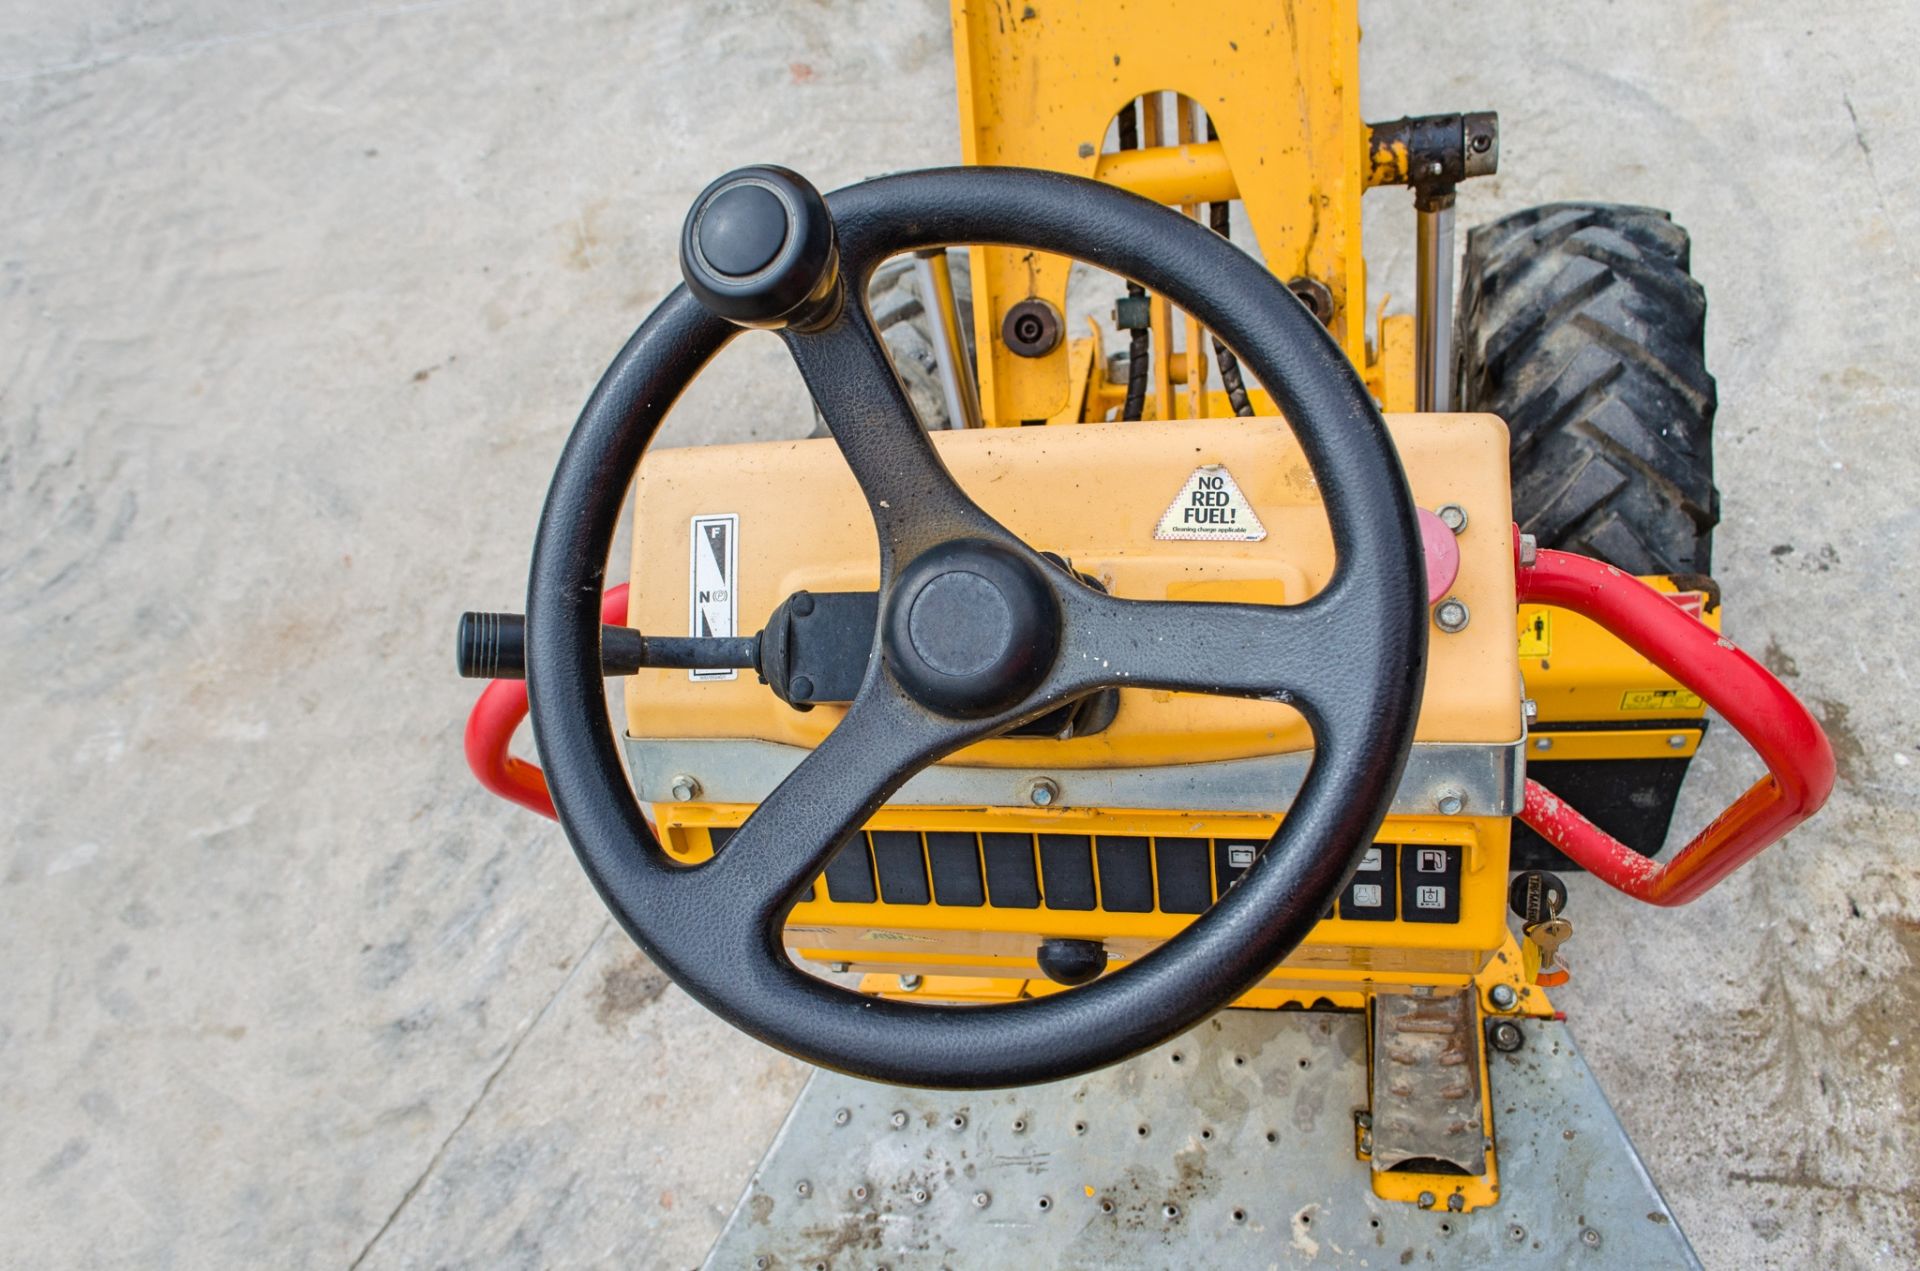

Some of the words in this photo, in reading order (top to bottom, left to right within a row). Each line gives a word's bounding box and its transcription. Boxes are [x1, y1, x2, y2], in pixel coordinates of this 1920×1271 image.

[1198, 477, 1224, 490] NO
[1191, 491, 1230, 506] RED
[1184, 508, 1236, 524] FUEL!
[711, 528, 720, 539] F
[699, 591, 710, 603] N
